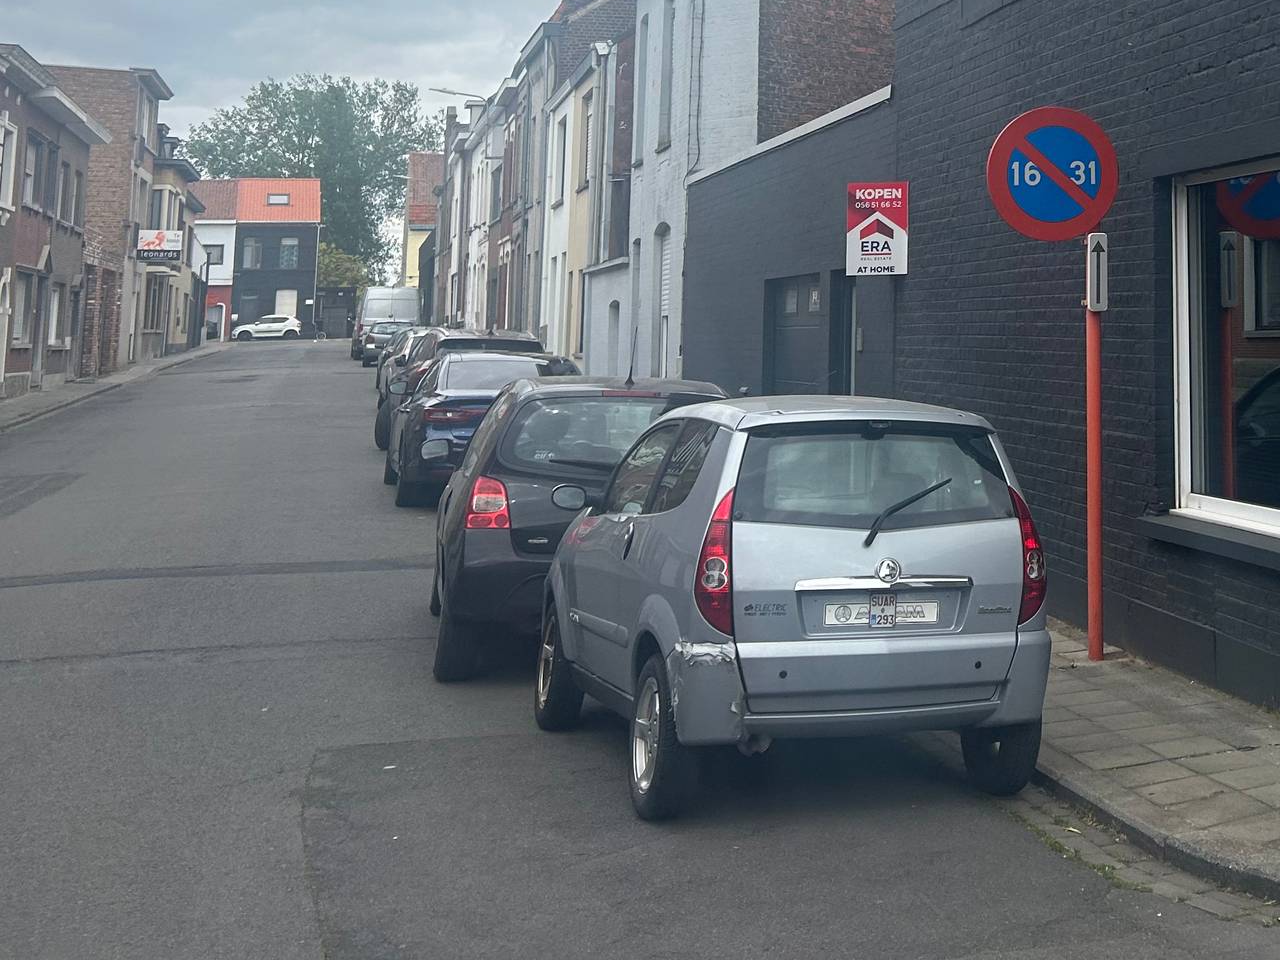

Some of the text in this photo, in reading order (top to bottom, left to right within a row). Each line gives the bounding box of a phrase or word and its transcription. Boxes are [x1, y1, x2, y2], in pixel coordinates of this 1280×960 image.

[1012, 160, 1096, 186] 16 31
[855, 188, 902, 199] KOPEN
[855, 201, 870, 209] 056
[892, 200, 902, 208] 52
[861, 240, 892, 252] ERA
[140, 250, 178, 258] leonards
[870, 265, 895, 273] HOME
[871, 596, 895, 607] SUAR
[877, 614, 894, 625] 293
